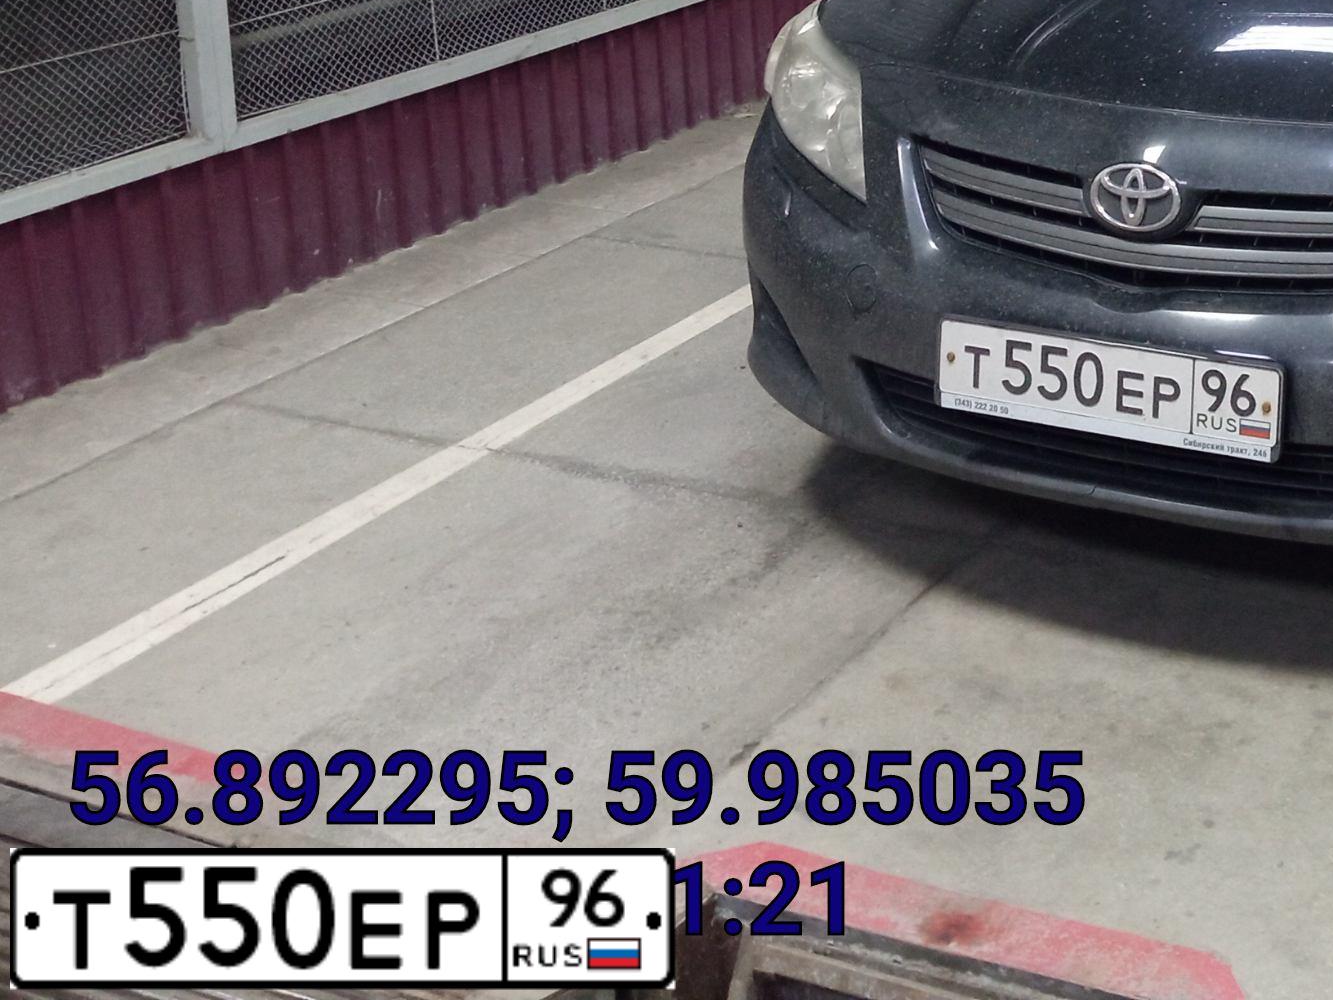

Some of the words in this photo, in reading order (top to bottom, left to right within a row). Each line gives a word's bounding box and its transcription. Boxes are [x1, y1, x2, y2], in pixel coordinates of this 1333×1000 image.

[964, 339, 1181, 418] Т550ЕР
[1201, 369, 1257, 417] 96
[954, 398, 973, 409] (343)
[974, 401, 988, 411] 222
[989, 404, 998, 413] 20
[1196, 413, 1237, 433] RUS
[1183, 437, 1225, 451] Сибирский
[1227, 444, 1251, 456] тракт,
